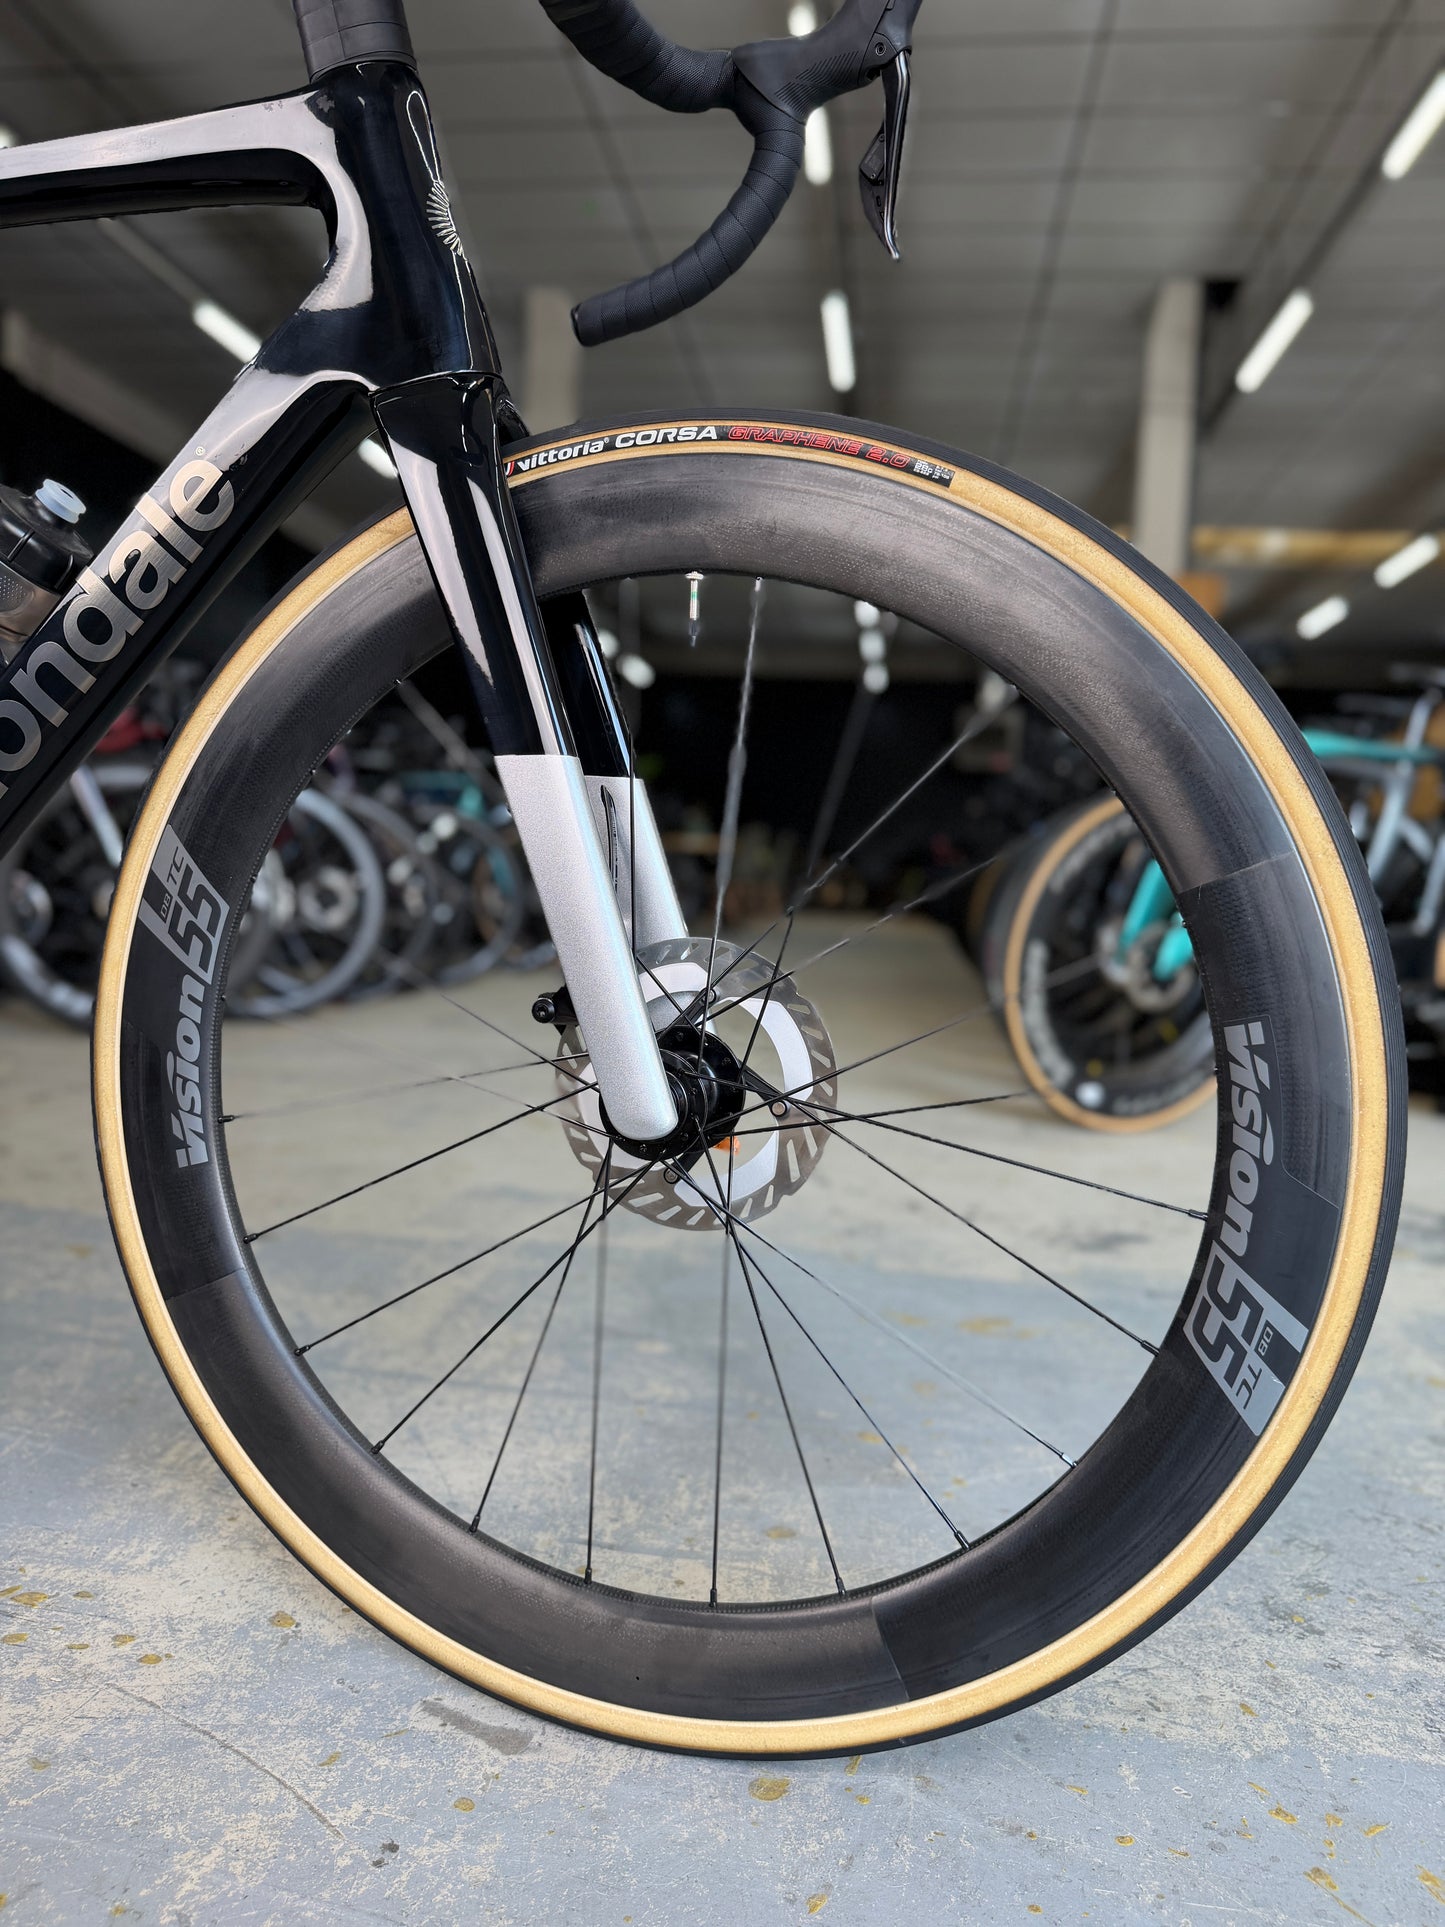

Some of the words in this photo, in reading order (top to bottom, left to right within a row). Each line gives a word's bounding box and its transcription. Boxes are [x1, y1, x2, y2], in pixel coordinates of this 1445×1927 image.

[615, 426, 718, 448] CORSA
[728, 426, 864, 456] GRAPHENE
[865, 446, 910, 468] 2.0
[0, 459, 235, 799] ondale
[167, 845, 185, 886] TC
[160, 893, 172, 920] DB
[167, 863, 222, 975] 55
[166, 973, 208, 1168] Vision
[1219, 1021, 1274, 1257] Vision
[1192, 1254, 1265, 1388] 55
[1258, 1326, 1274, 1357] DB
[1236, 1364, 1263, 1410] TC
